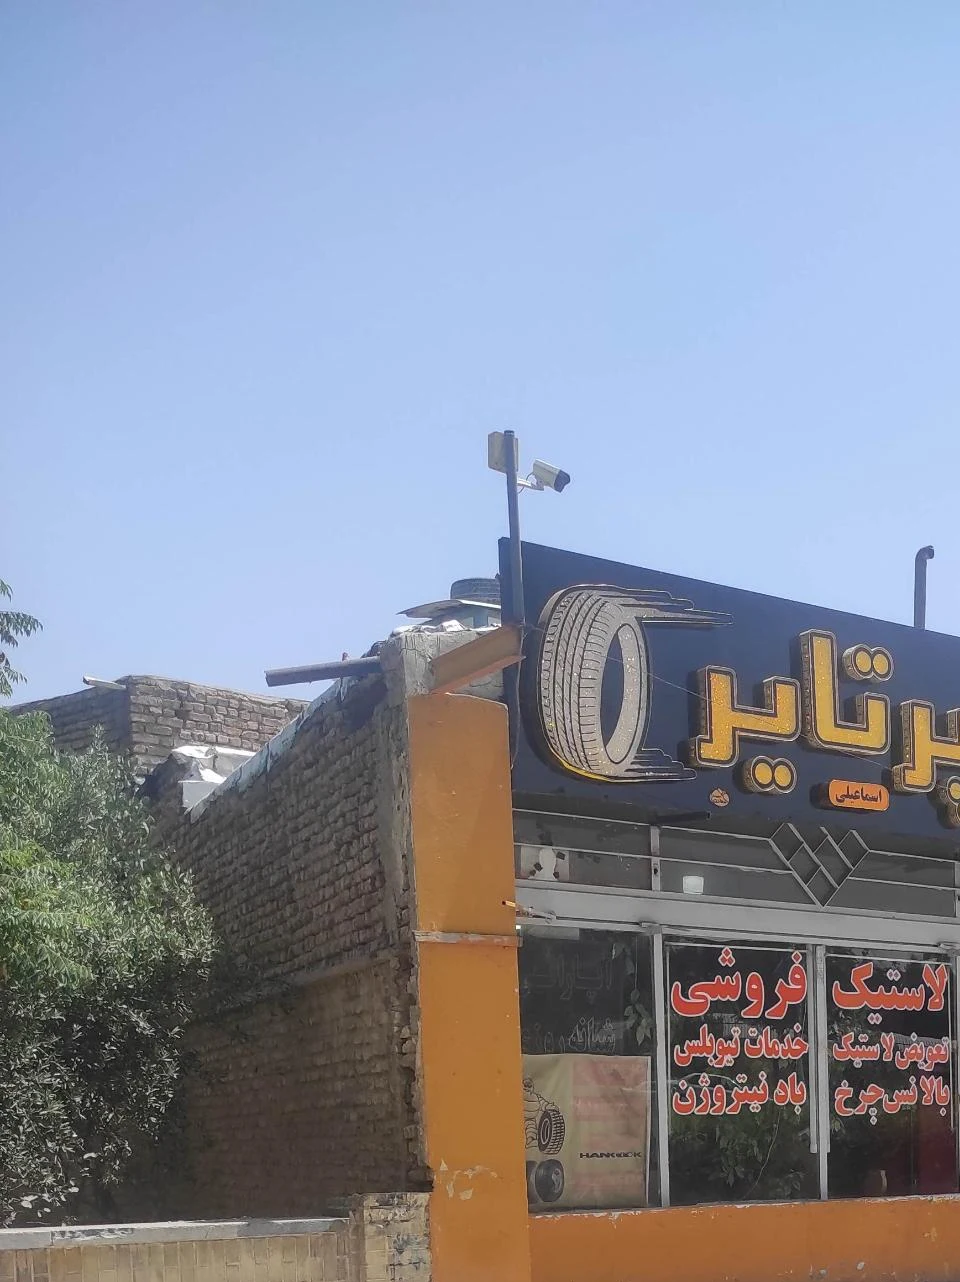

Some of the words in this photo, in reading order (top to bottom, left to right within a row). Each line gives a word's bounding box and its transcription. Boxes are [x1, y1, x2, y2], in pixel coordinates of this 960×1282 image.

[689, 628, 893, 795] تایر
[835, 785, 882, 804] اسماعیلی
[671, 946, 808, 1020] فروشی
[832, 962, 948, 1025] لاستیک
[674, 1023, 741, 1068] تیوبلس
[744, 1023, 809, 1060] خدمات
[895, 1032, 949, 1072] تعویض
[672, 1070, 769, 1115] نیتروژن
[773, 1071, 807, 1115] باد
[834, 1079, 885, 1126] چرخ
